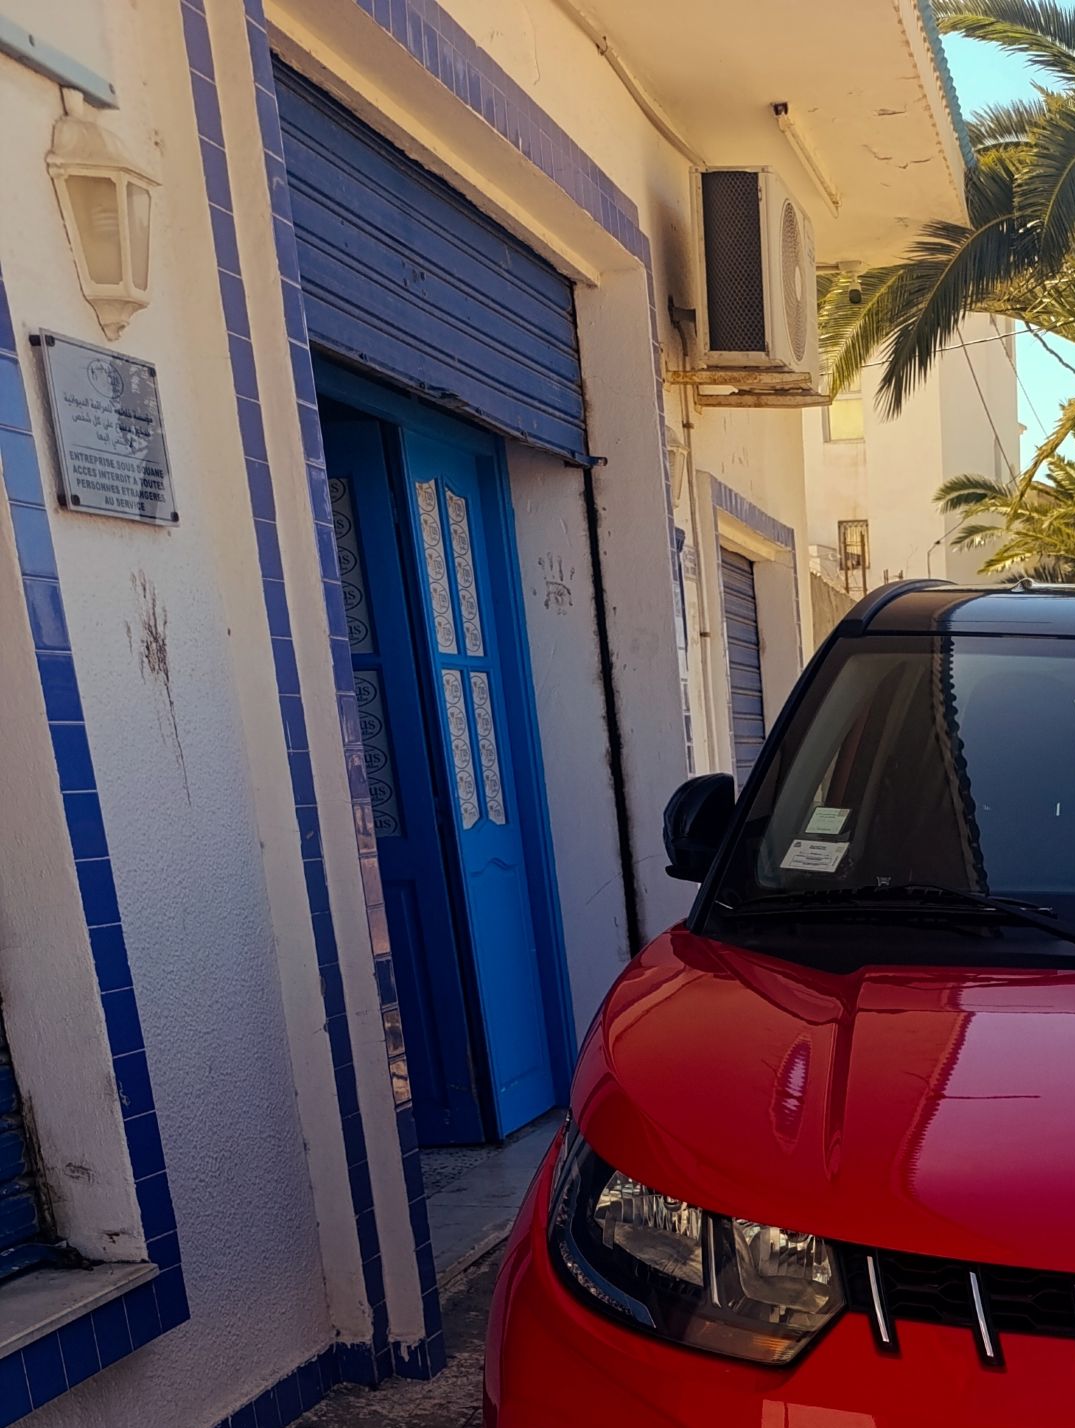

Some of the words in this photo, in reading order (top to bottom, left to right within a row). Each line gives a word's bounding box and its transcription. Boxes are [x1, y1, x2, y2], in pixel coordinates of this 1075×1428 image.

[69, 451, 116, 469] ENTREPRISE
[116, 460, 135, 473] SOUS
[136, 462, 165, 479] DOUANE
[72, 464, 97, 478] ACCES
[98, 469, 131, 485] INTERDIT
[132, 477, 138, 486] A
[139, 478, 165, 491] TOUTES
[76, 478, 121, 495] PERSONNES
[121, 486, 166, 503] ETRANGERES
[104, 496, 114, 506] AU
[116, 498, 145, 512] SERVICE
